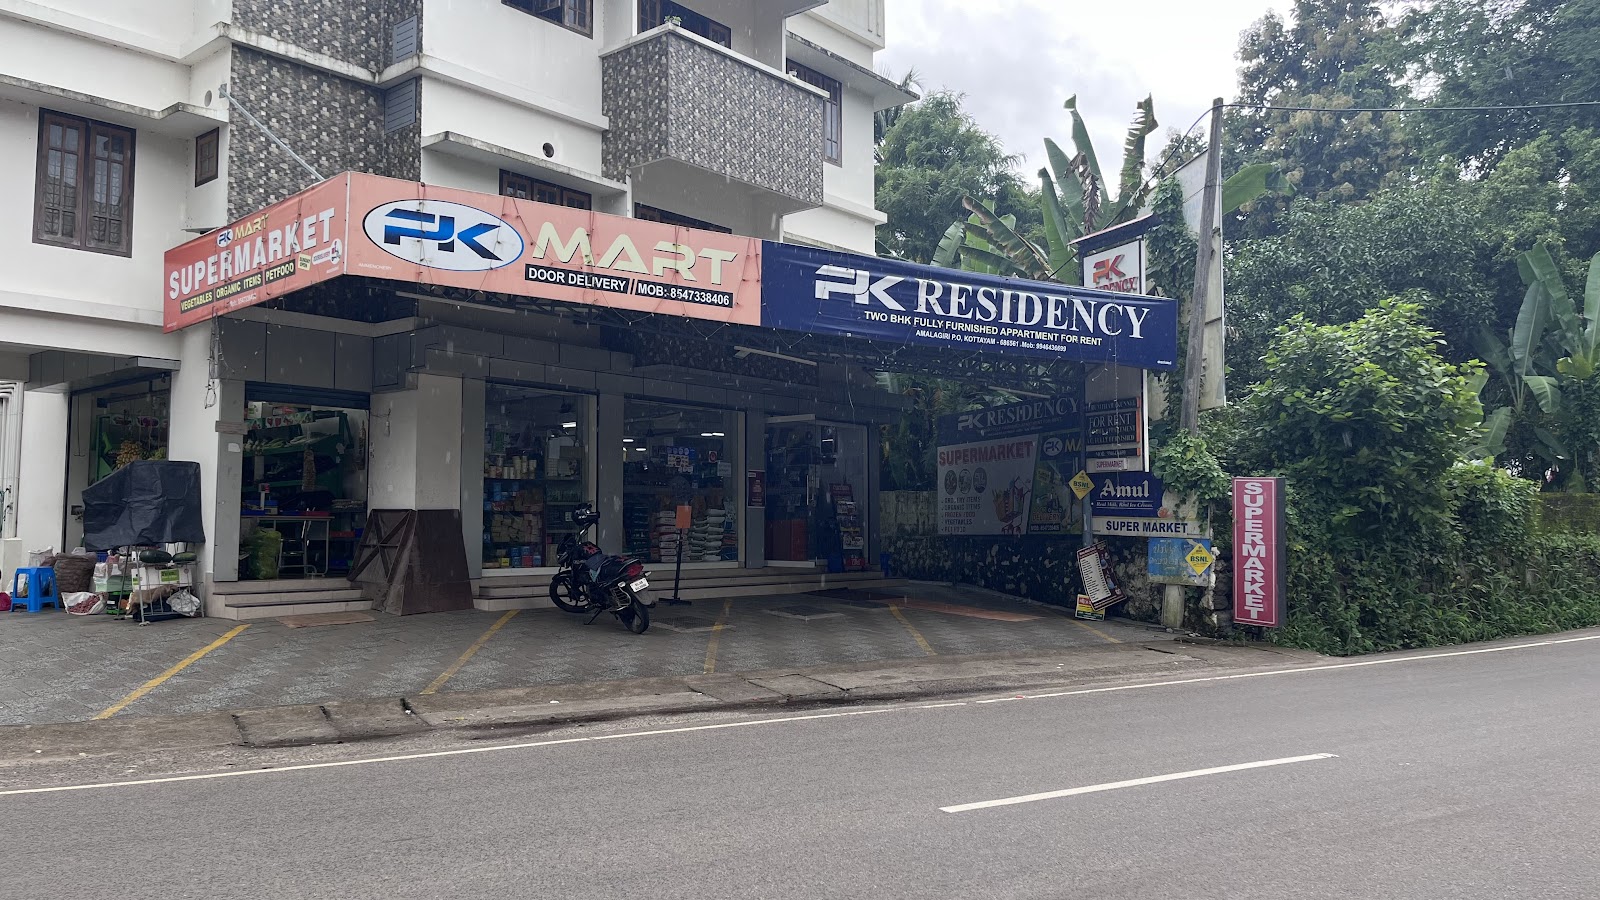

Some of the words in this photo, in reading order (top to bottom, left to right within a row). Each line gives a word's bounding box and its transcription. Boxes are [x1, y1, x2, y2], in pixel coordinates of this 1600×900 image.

[234, 213, 269, 240] MART
[169, 207, 335, 300] SUPERMARKET
[384, 208, 503, 261] PK
[532, 221, 738, 286] MART
[1093, 254, 1126, 284] PK
[181, 291, 213, 312] VEGETABLES
[216, 281, 241, 298] ORGANIC
[243, 274, 262, 289] ITEMS
[266, 262, 295, 281] PETFOOD
[528, 267, 565, 283] DOOR
[568, 272, 627, 292] DELIVERY
[638, 283, 667, 297] MOB:
[670, 287, 730, 306] 8547338406
[814, 264, 906, 312] PK
[914, 278, 1150, 339] RESIDENCY
[864, 311, 888, 322] TWO
[891, 314, 912, 325] BHK
[914, 317, 943, 329] FULLY
[946, 321, 998, 335] FURNISHED
[1000, 328, 1059, 342] APPARTMENT
[1061, 334, 1079, 344] FOR
[1080, 337, 1102, 346] RENT
[915, 330, 950, 340] AMALAGIRI
[964, 335, 996, 345] KOTTAYAM
[958, 413, 984, 430] PK
[987, 398, 1079, 427] RESIDENCY
[1089, 416, 1105, 428] FOR
[1108, 413, 1131, 426] RENT
[938, 440, 1034, 466] SUPERMARKET
[1100, 479, 1149, 499] Amul
[1106, 520, 1139, 532] SUPER
[1143, 522, 1188, 533] MARKET
[1190, 555, 1209, 563] BSNL
[1242, 482, 1266, 619] SUPERMARKET
